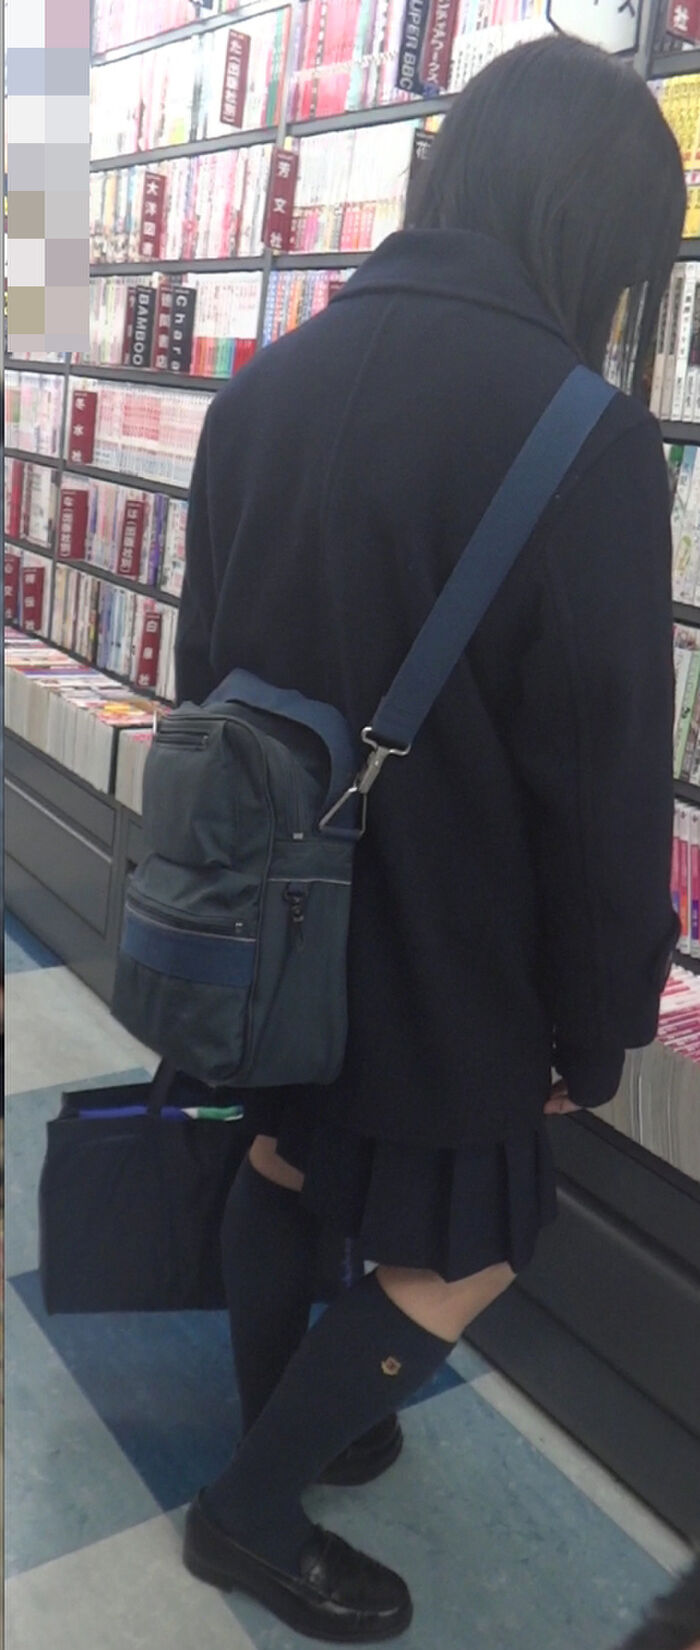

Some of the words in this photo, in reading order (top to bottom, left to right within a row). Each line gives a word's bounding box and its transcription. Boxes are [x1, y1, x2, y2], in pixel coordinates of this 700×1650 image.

[399, 51, 417, 90] BBC
[132, 293, 150, 366] BAMBOO
[170, 295, 188, 371] Chara
